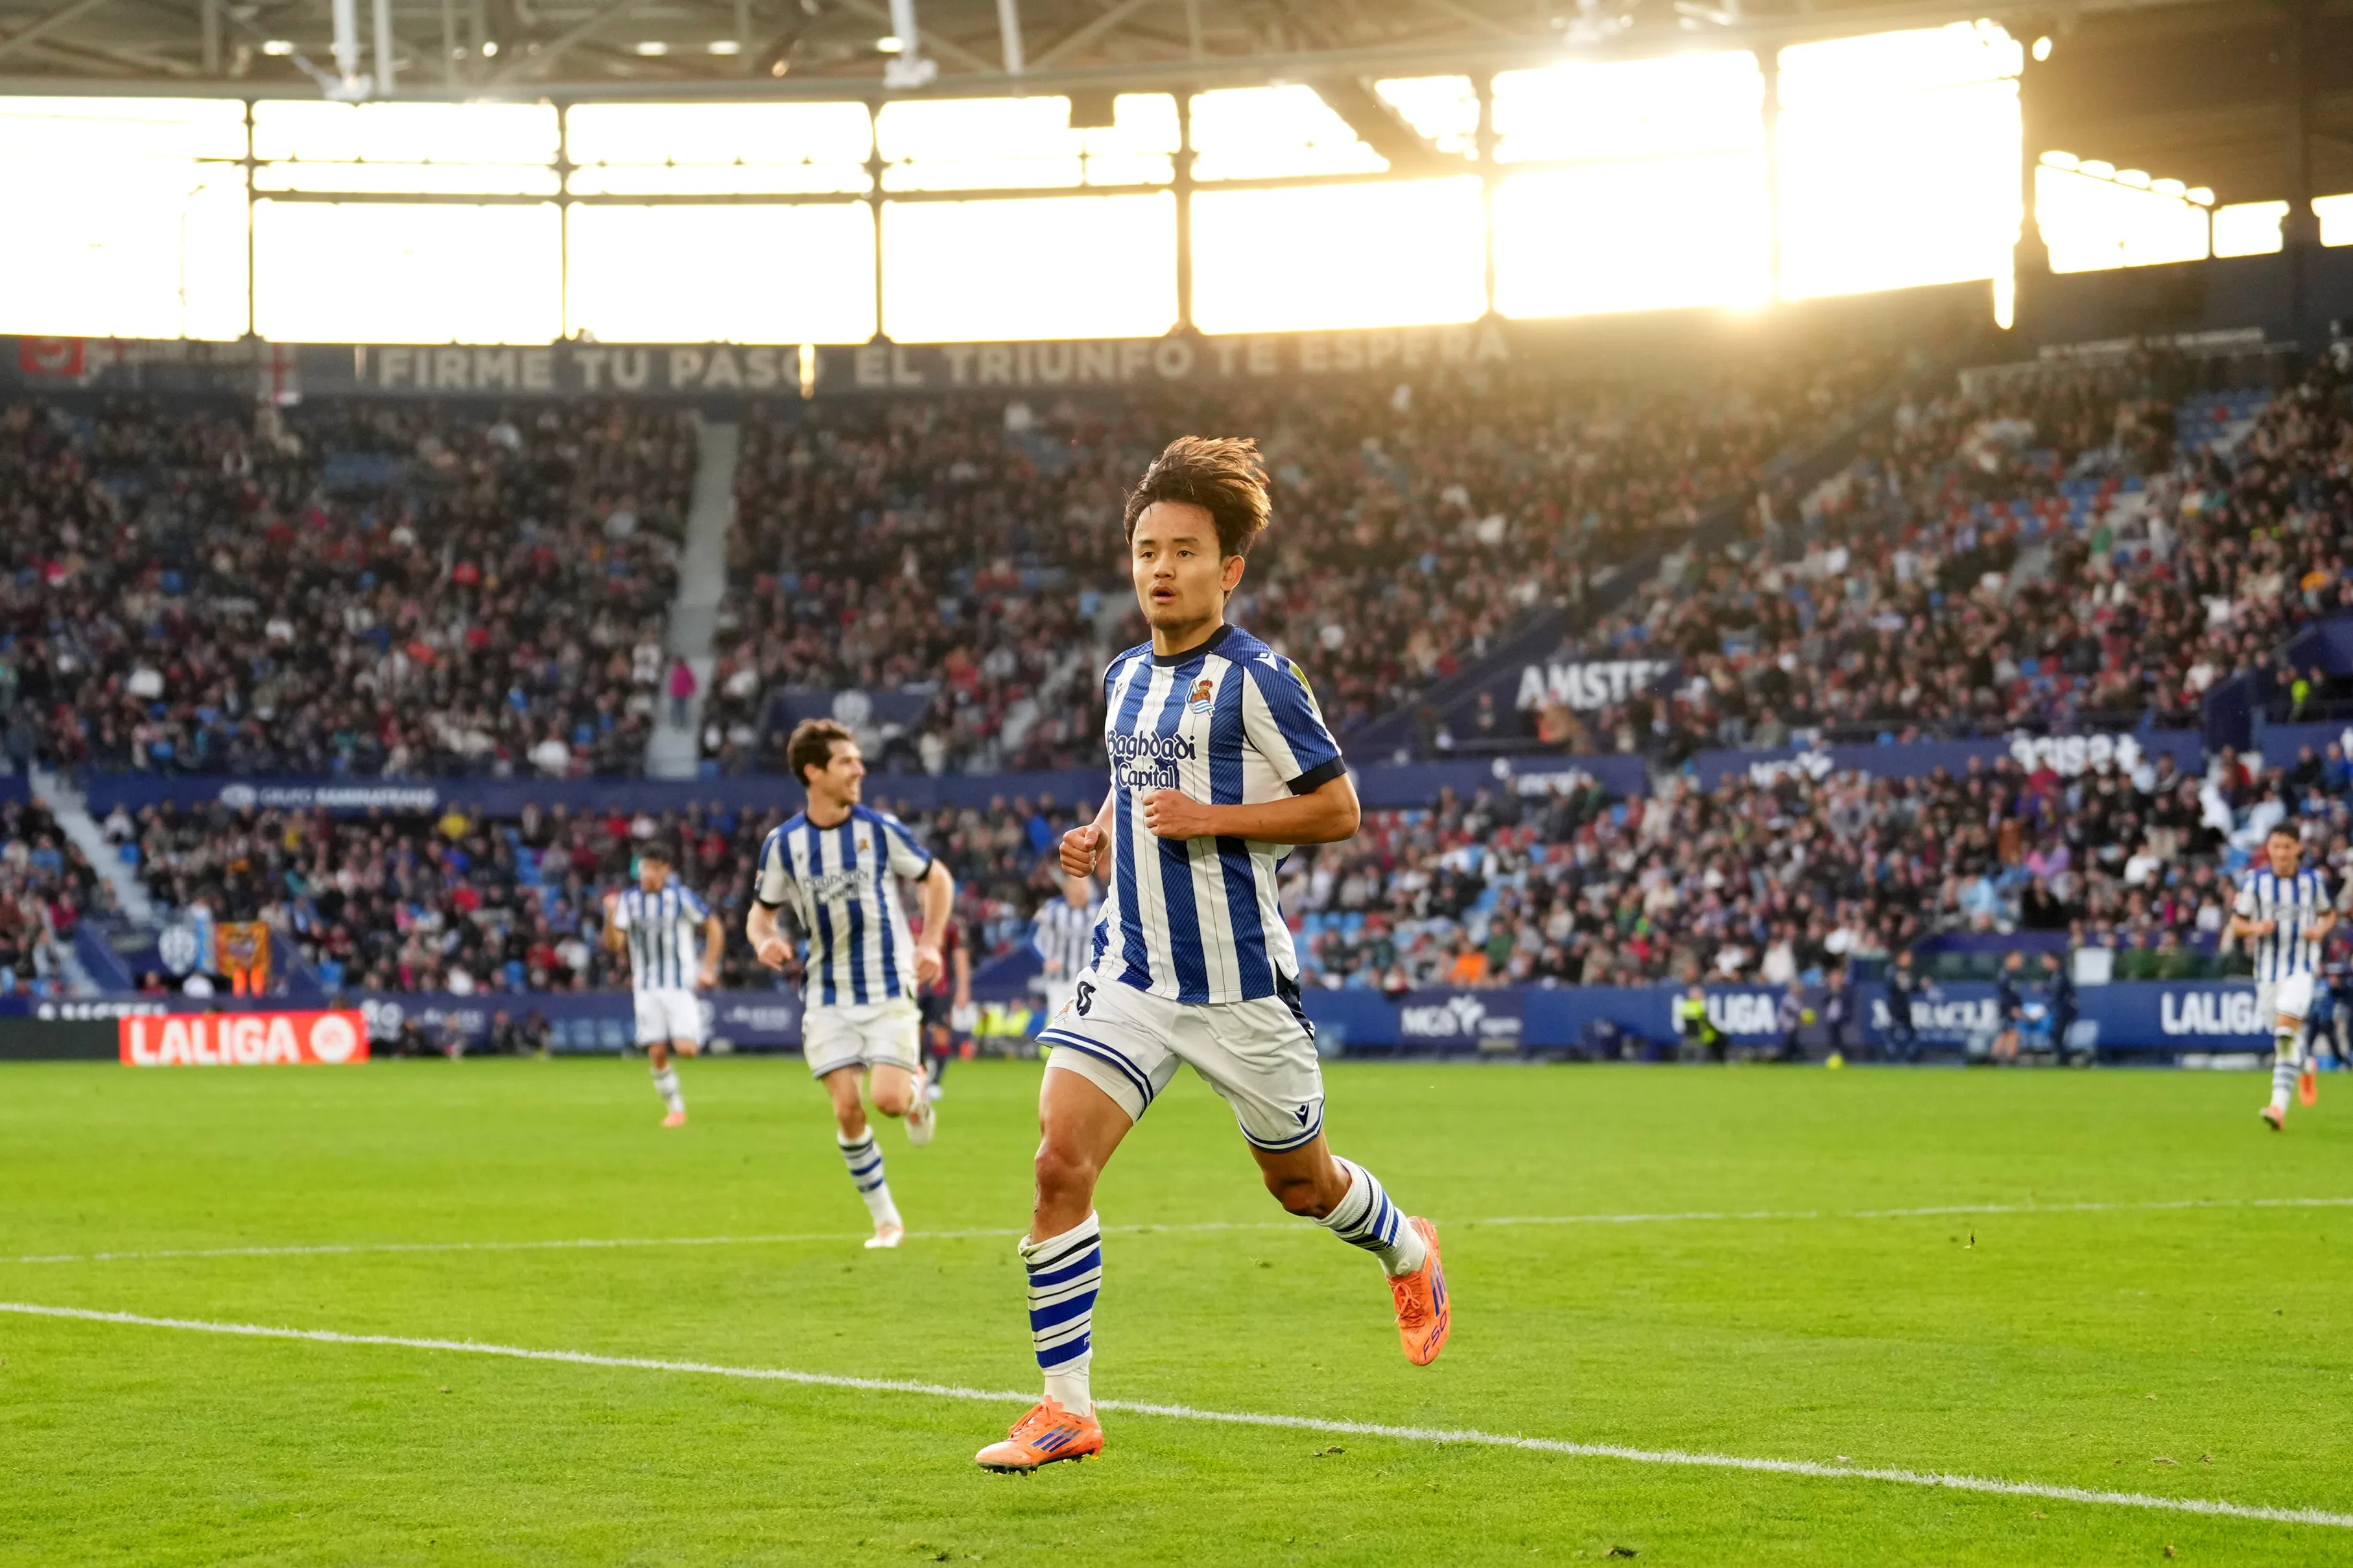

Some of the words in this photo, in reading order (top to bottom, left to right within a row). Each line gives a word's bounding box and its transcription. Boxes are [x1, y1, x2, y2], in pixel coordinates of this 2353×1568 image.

[379, 348, 554, 389] FIRME
[573, 347, 648, 390] TU
[669, 347, 822, 390] PASO
[855, 345, 923, 386] EL
[941, 338, 1193, 386] TRIUNFO
[1209, 336, 1277, 377] TE
[1299, 322, 1509, 372] ESPERA
[1106, 729, 1198, 762] Baghdadi
[1118, 762, 1175, 791] Capital
[130, 1015, 302, 1066] LALIGA
[1423, 1309, 1447, 1361] F50
